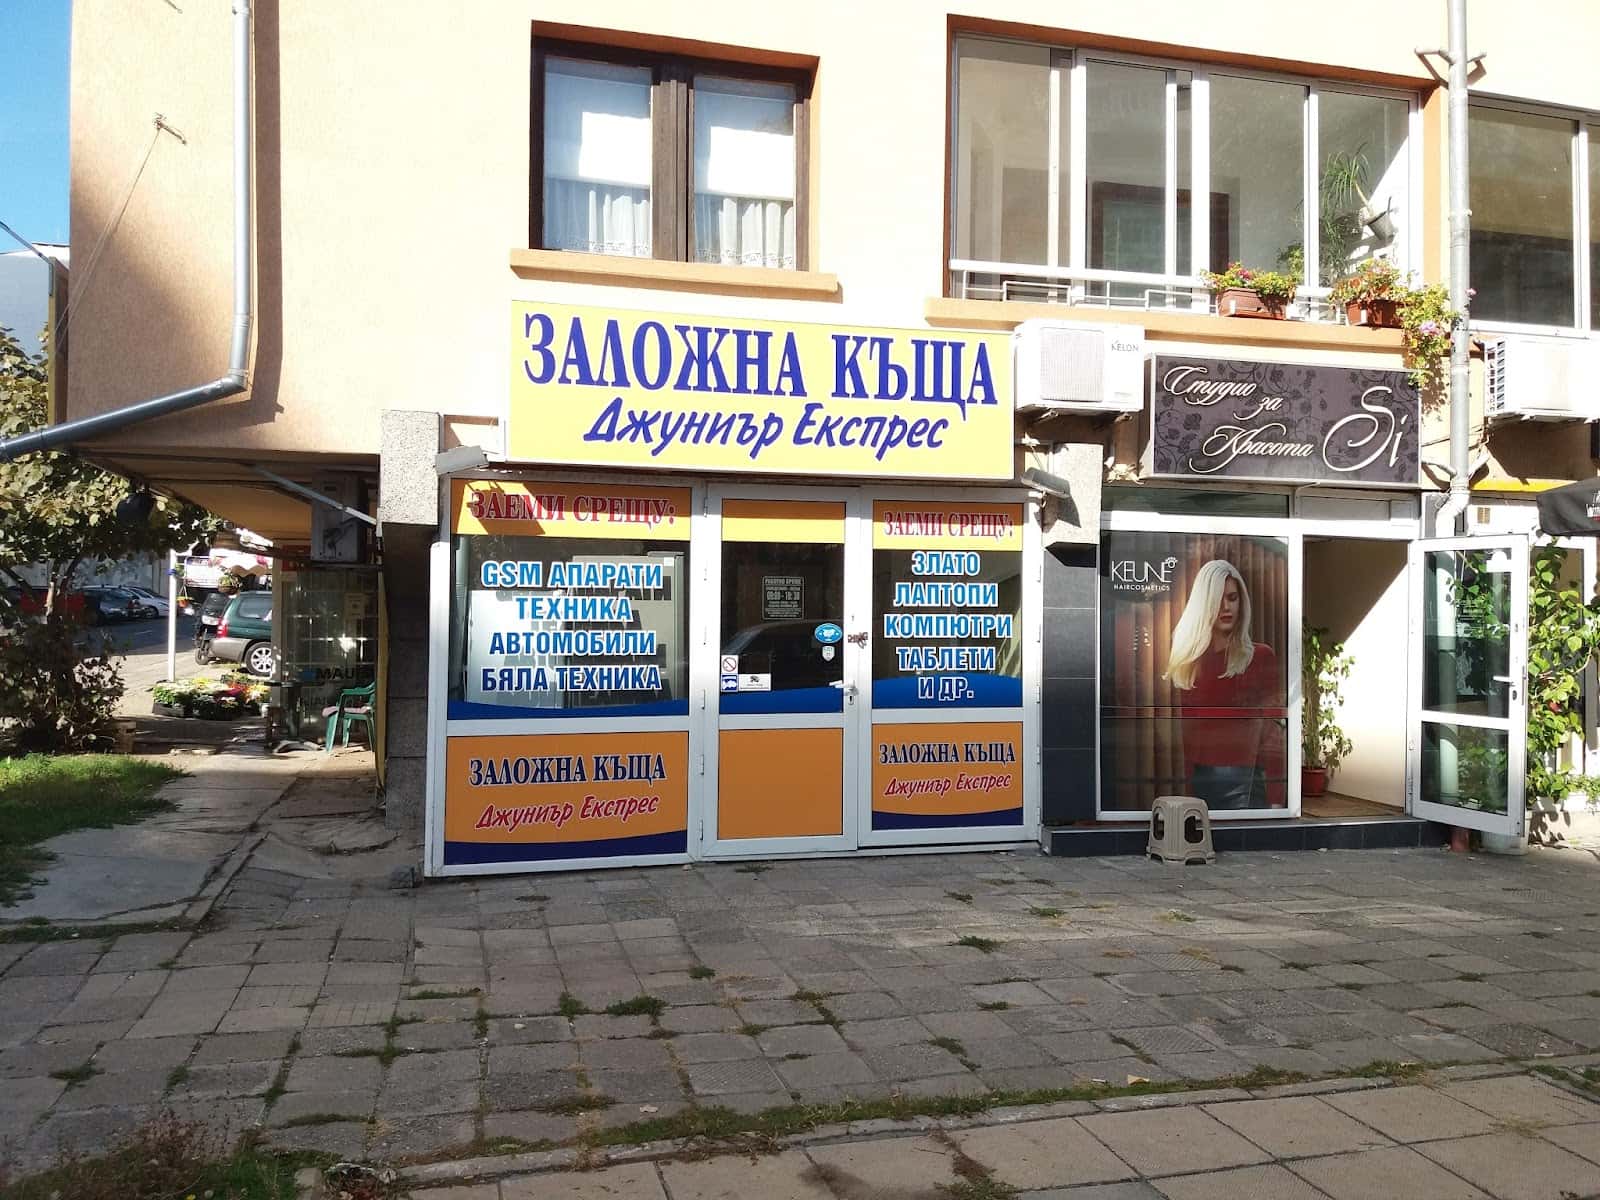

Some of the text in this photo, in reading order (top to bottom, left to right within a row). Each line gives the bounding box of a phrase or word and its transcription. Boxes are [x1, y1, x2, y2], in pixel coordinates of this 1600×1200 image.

[524, 312, 998, 421] ЗАЛОЖНА КЪЩА
[1163, 366, 1257, 406] Студио
[1233, 395, 1283, 421] за
[583, 396, 949, 461] Джуниър Експрес
[1322, 386, 1408, 472] Si
[1188, 422, 1315, 473] Красота
[470, 490, 677, 529] ЗАЕМИ СРЕЩУ:
[884, 511, 1014, 540] ЗАЕМИ СРЕЩУ:
[481, 561, 664, 589] GSM АПАРАТИ
[912, 551, 981, 576] ЗЛАТО
[1111, 560, 1174, 583] KEUNE
[894, 582, 998, 607] ЛАПТОПИ
[513, 596, 634, 623] ТЕХНИКА
[884, 614, 1013, 639] КОМПЮТРИ
[488, 630, 657, 656] АВТОМОБИЛИ
[896, 647, 996, 671] ТАБЛЕТИ
[480, 665, 662, 692] БЯЛА ТЕХНИКА
[918, 677, 975, 701] И ДР.
[879, 742, 1016, 768] ЗАЛОЖНА КЪЩА
[469, 753, 667, 787] ЗАЛОЖНА КЪЩА
[884, 773, 1013, 799] Джуниър Експрес
[474, 795, 661, 832] Джуниър Експрес
